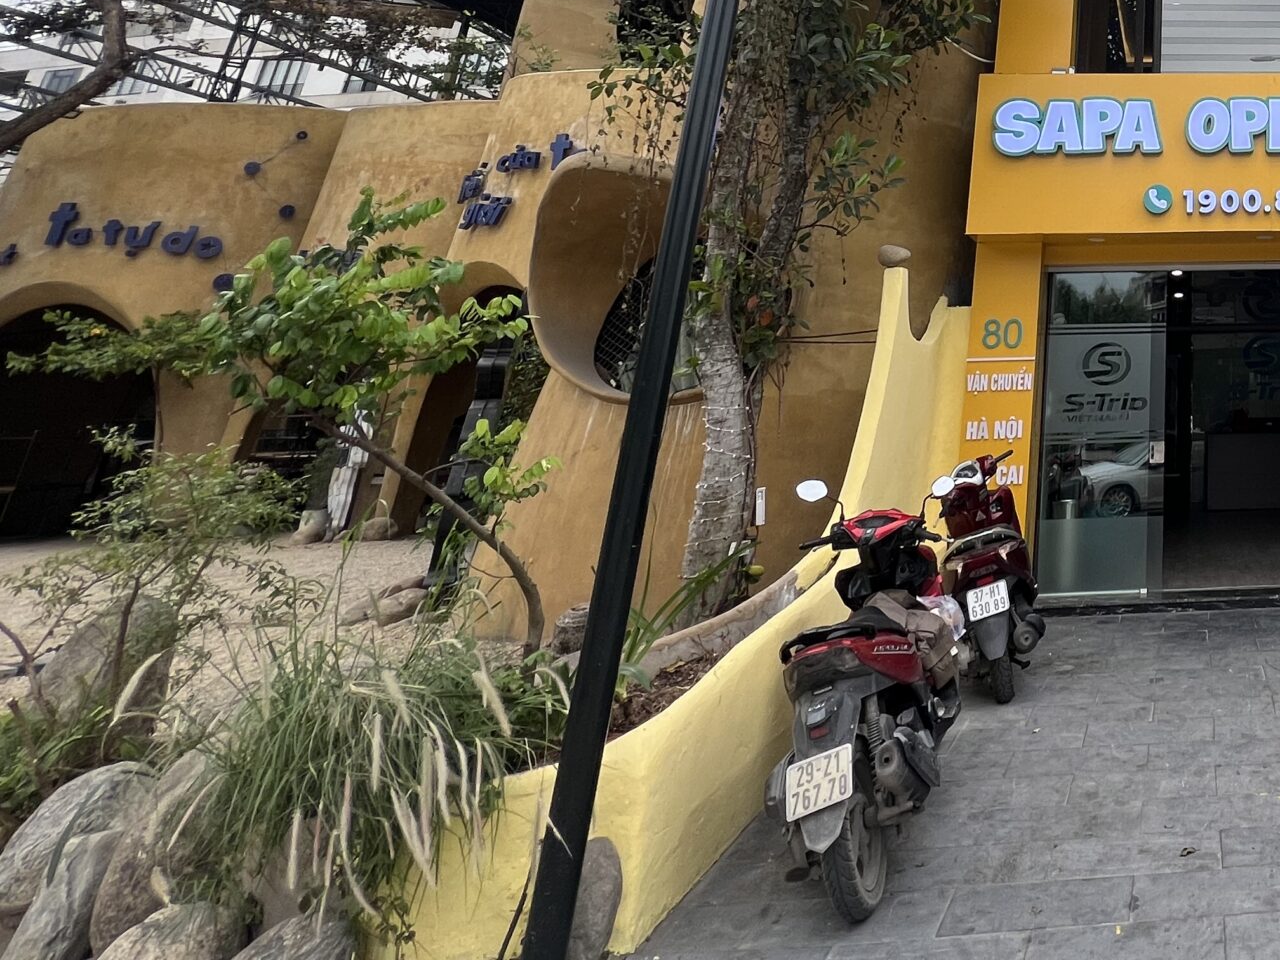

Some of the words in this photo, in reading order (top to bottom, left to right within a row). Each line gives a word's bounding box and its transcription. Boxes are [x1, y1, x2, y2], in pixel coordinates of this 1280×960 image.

[993, 97, 1163, 156] SAPA
[982, 318, 1023, 350] 80
[967, 370, 988, 395] VẬN
[966, 416, 989, 440] HÀ
[994, 415, 1023, 444] NỘI
[973, 584, 1001, 604] 37-H1
[796, 751, 840, 788] 29-Z1
